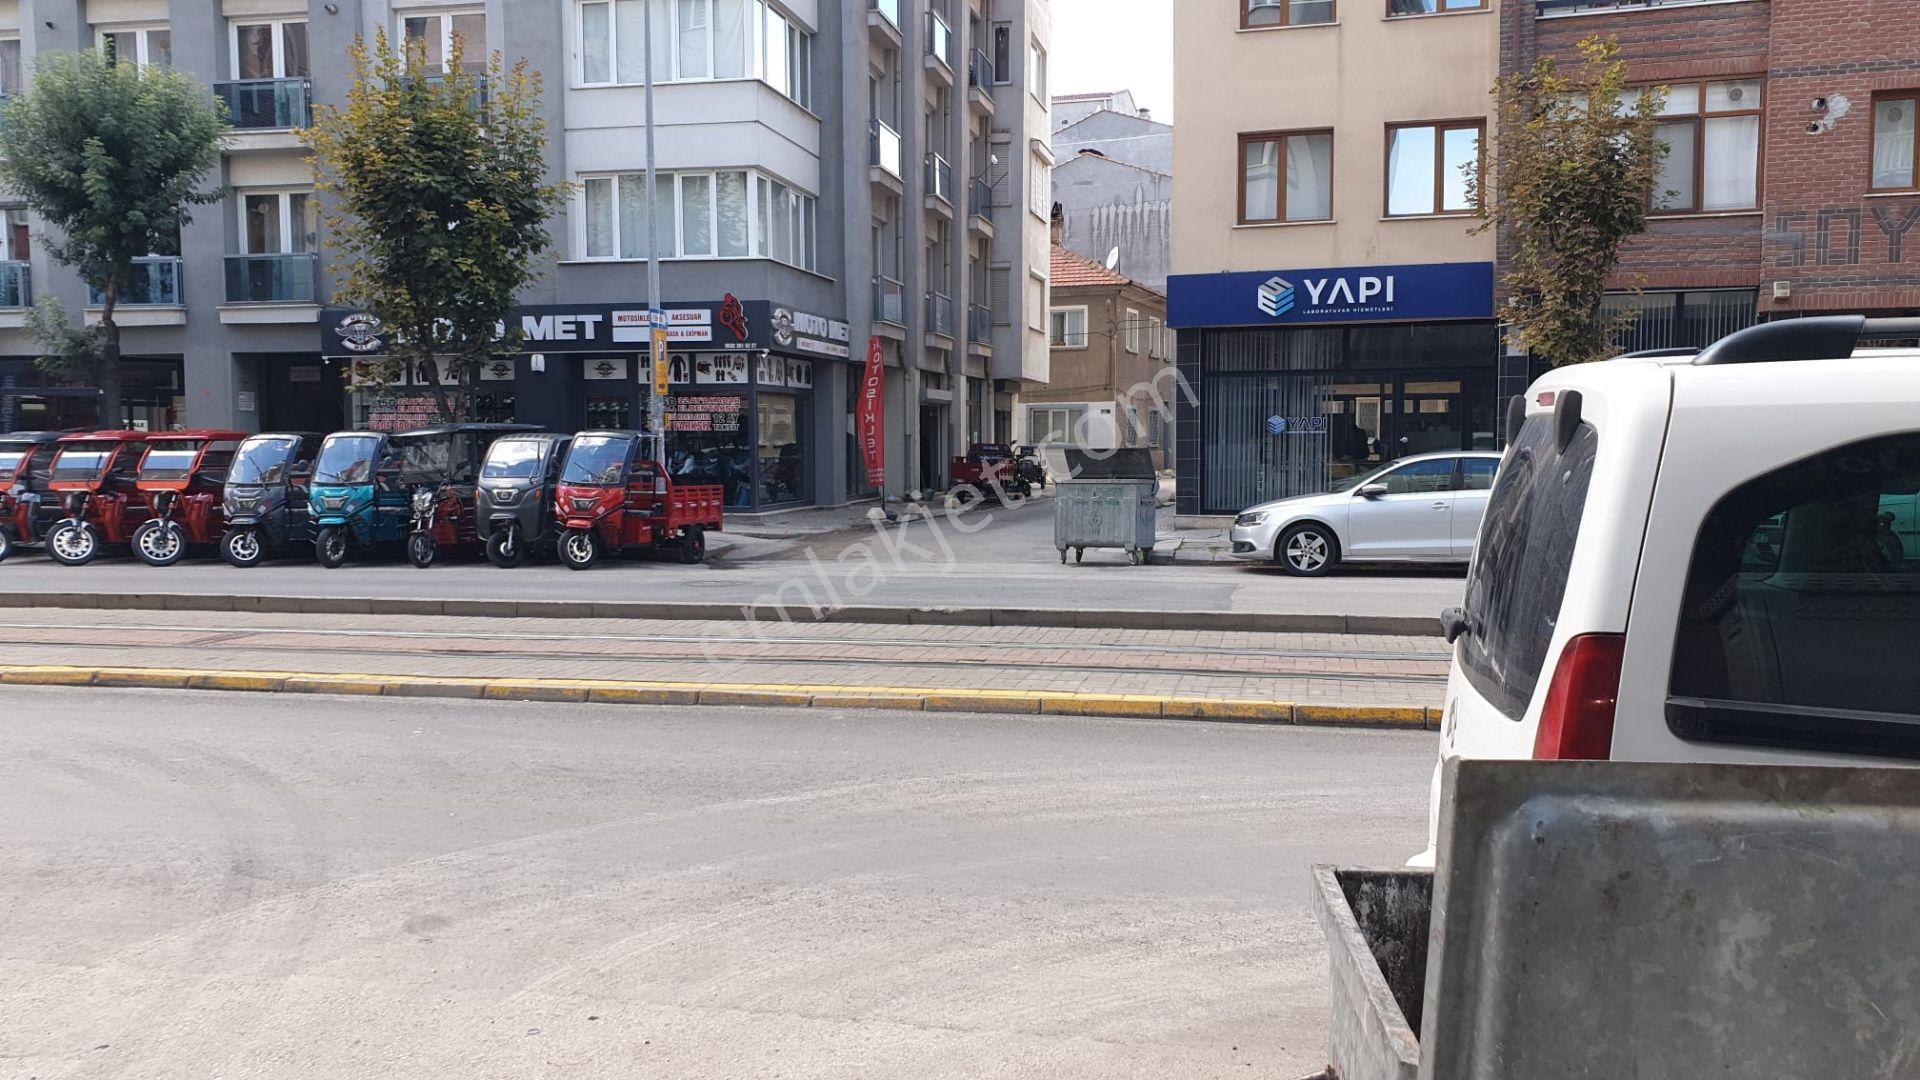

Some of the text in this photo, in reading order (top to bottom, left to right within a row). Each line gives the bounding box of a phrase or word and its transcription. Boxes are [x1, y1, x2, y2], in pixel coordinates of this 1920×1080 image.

[1303, 276, 1394, 305] YAPI
[522, 314, 603, 341] MET
[617, 312, 651, 322] MOTOSİKLE
[671, 313, 702, 321] AKSESUAR
[793, 311, 828, 338] MOTO
[1287, 416, 1328, 430] YAPI
